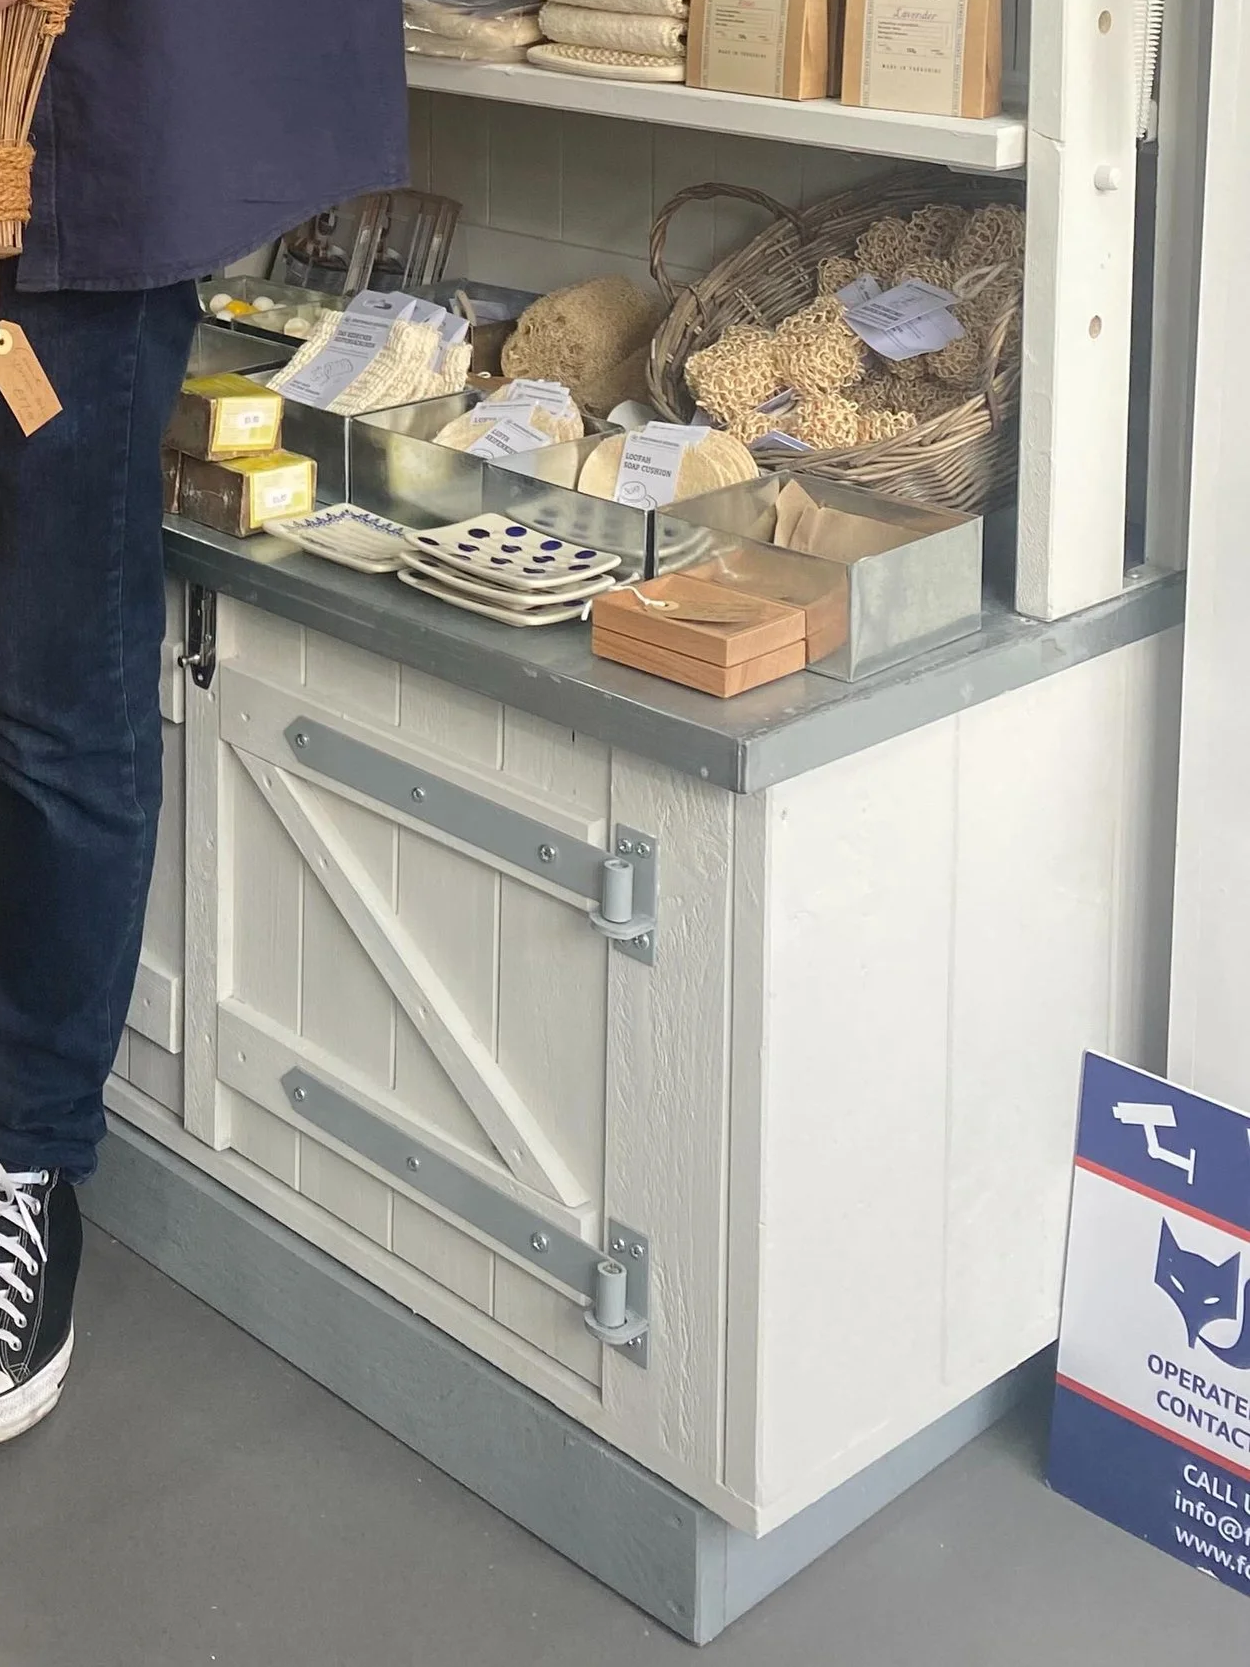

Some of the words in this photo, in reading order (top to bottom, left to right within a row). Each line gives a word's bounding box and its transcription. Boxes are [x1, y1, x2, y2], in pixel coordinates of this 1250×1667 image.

[893, 6, 938, 20] Lavender
[624, 461, 641, 471] SOAP
[1147, 1353, 1250, 1420] OPERATE
[1183, 1463, 1238, 1509] CALL
